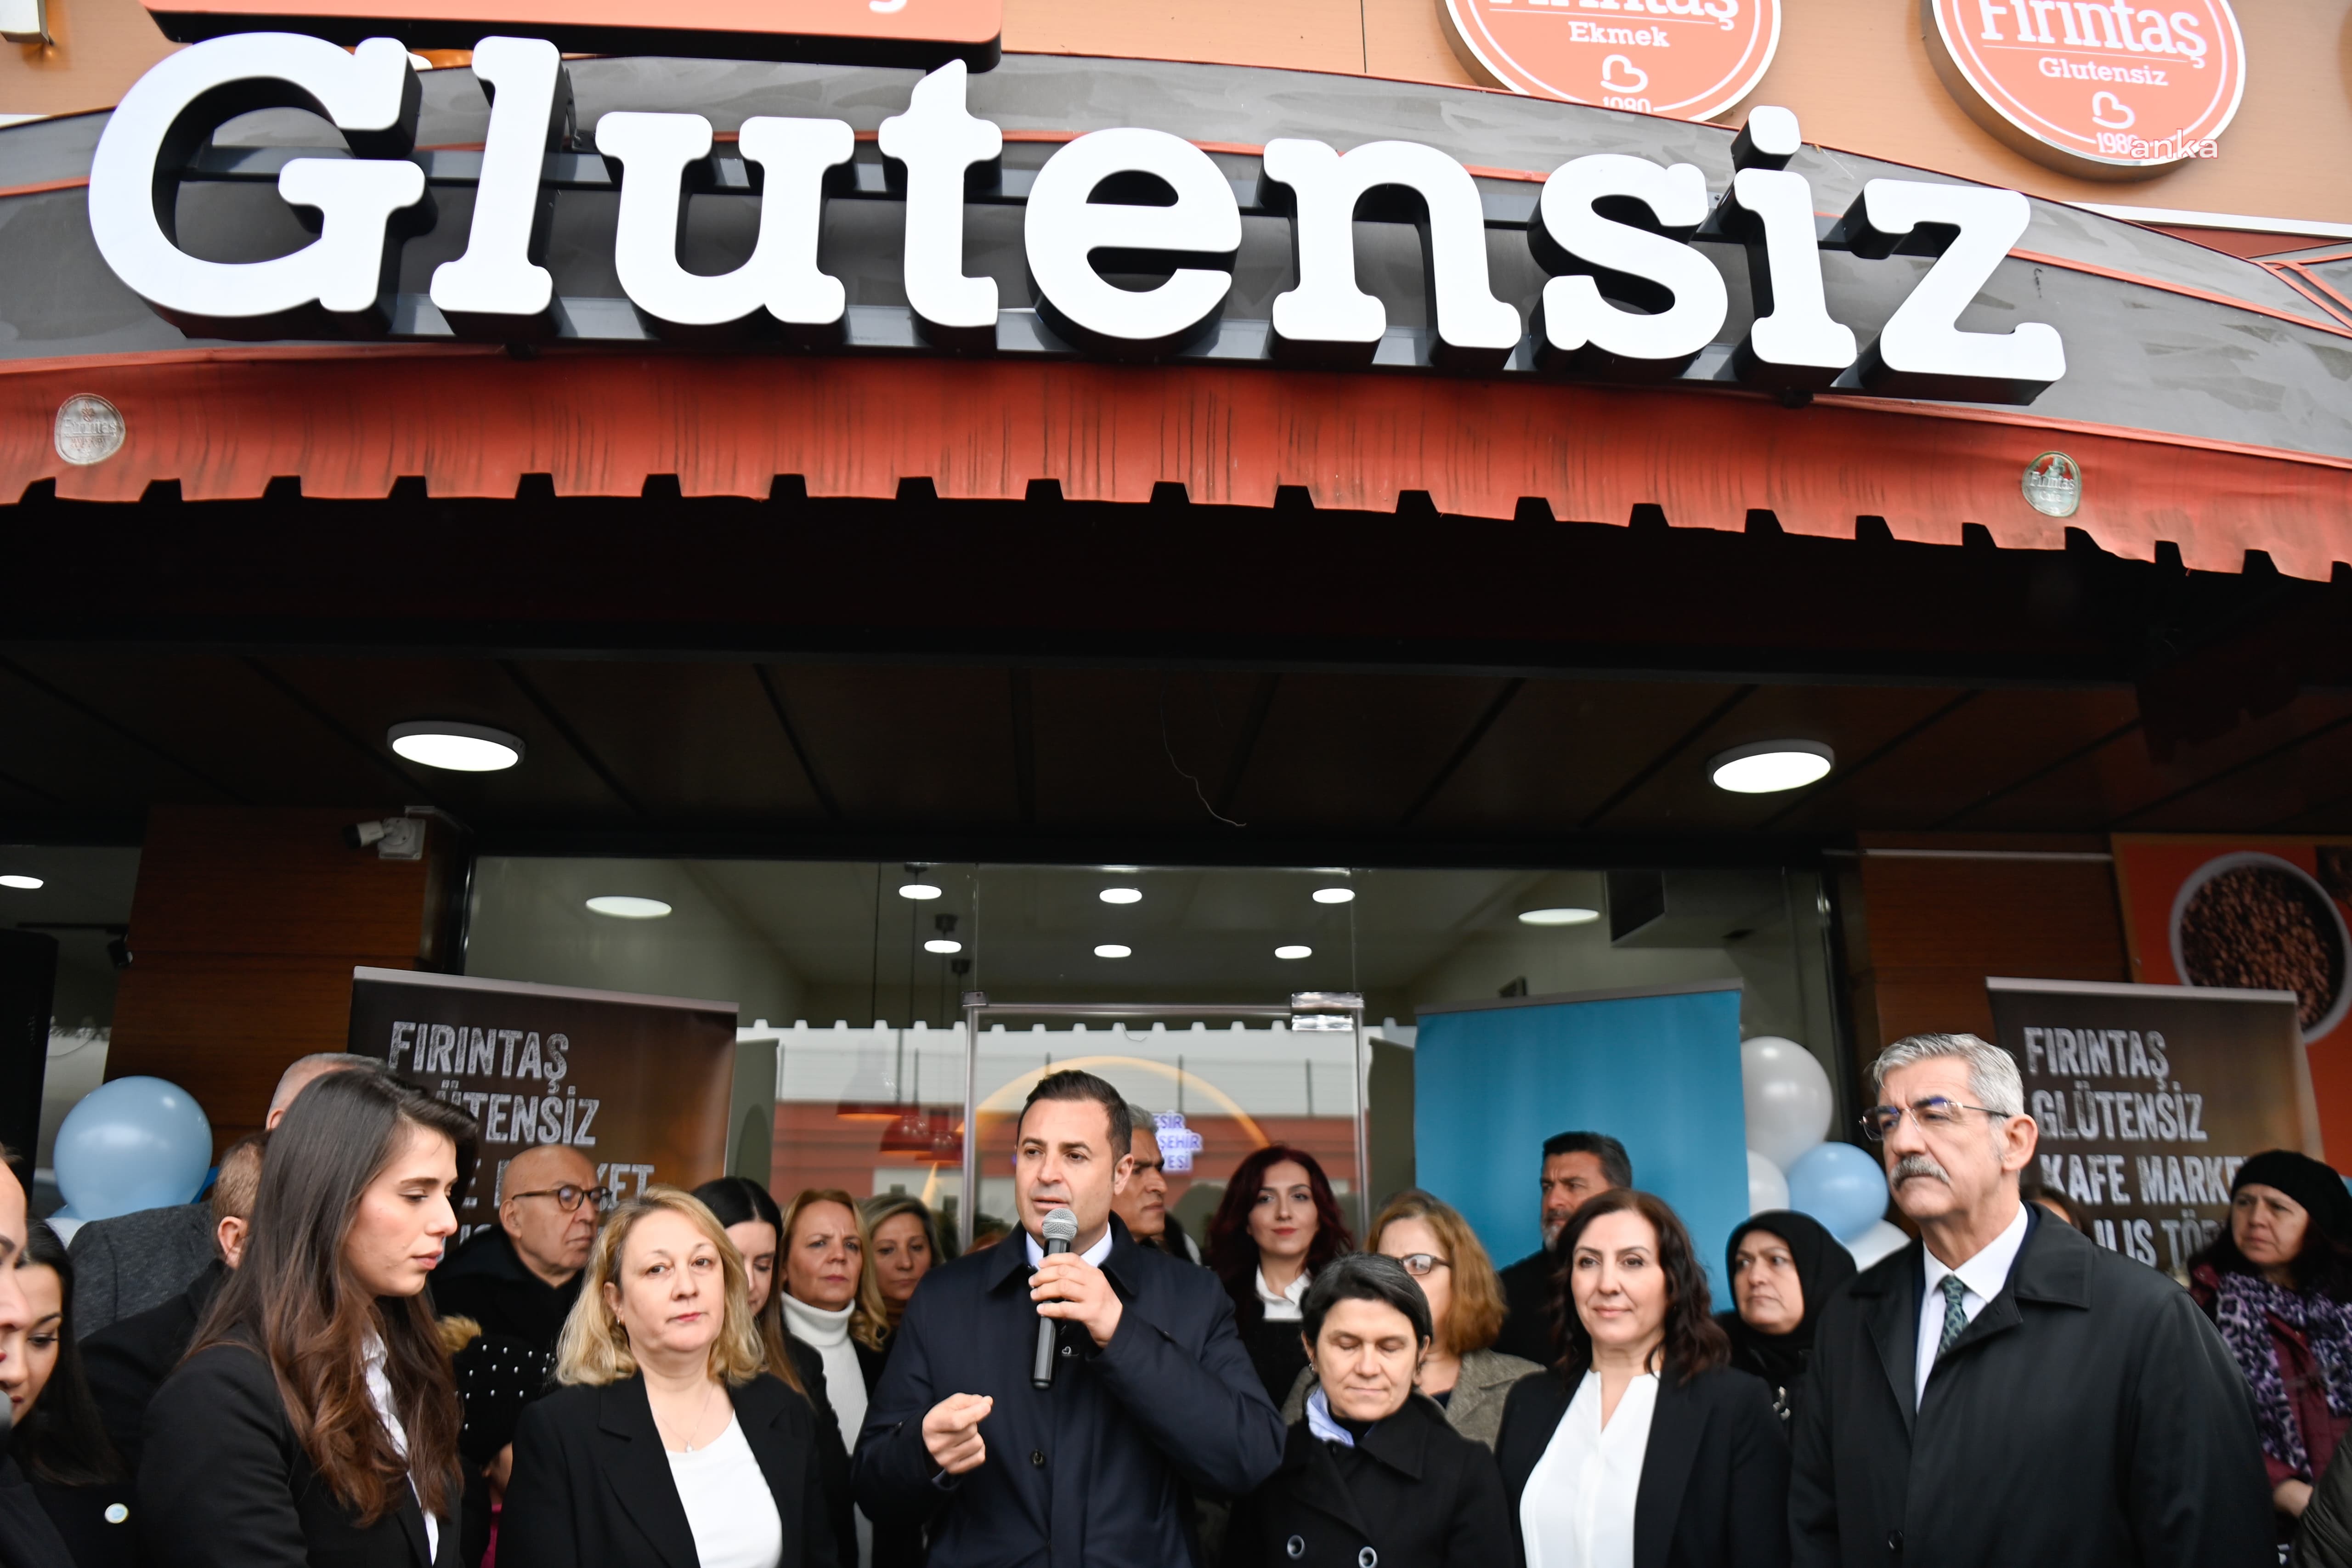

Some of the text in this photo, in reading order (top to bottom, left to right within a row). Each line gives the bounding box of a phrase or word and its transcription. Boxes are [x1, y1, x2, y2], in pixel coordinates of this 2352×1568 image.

[1568, 21, 1670, 47] Ekmek
[2038, 57, 2169, 86] Glutensiz
[87, 31, 2067, 382] Glutensiz
[388, 1020, 570, 1094] FIRINTAŞ
[2023, 1026, 2170, 1092] FIRINTAŞ
[2031, 1080, 2208, 1142] GLÜTENSİZ
[2039, 1154, 2247, 1205] KAFE MARK
